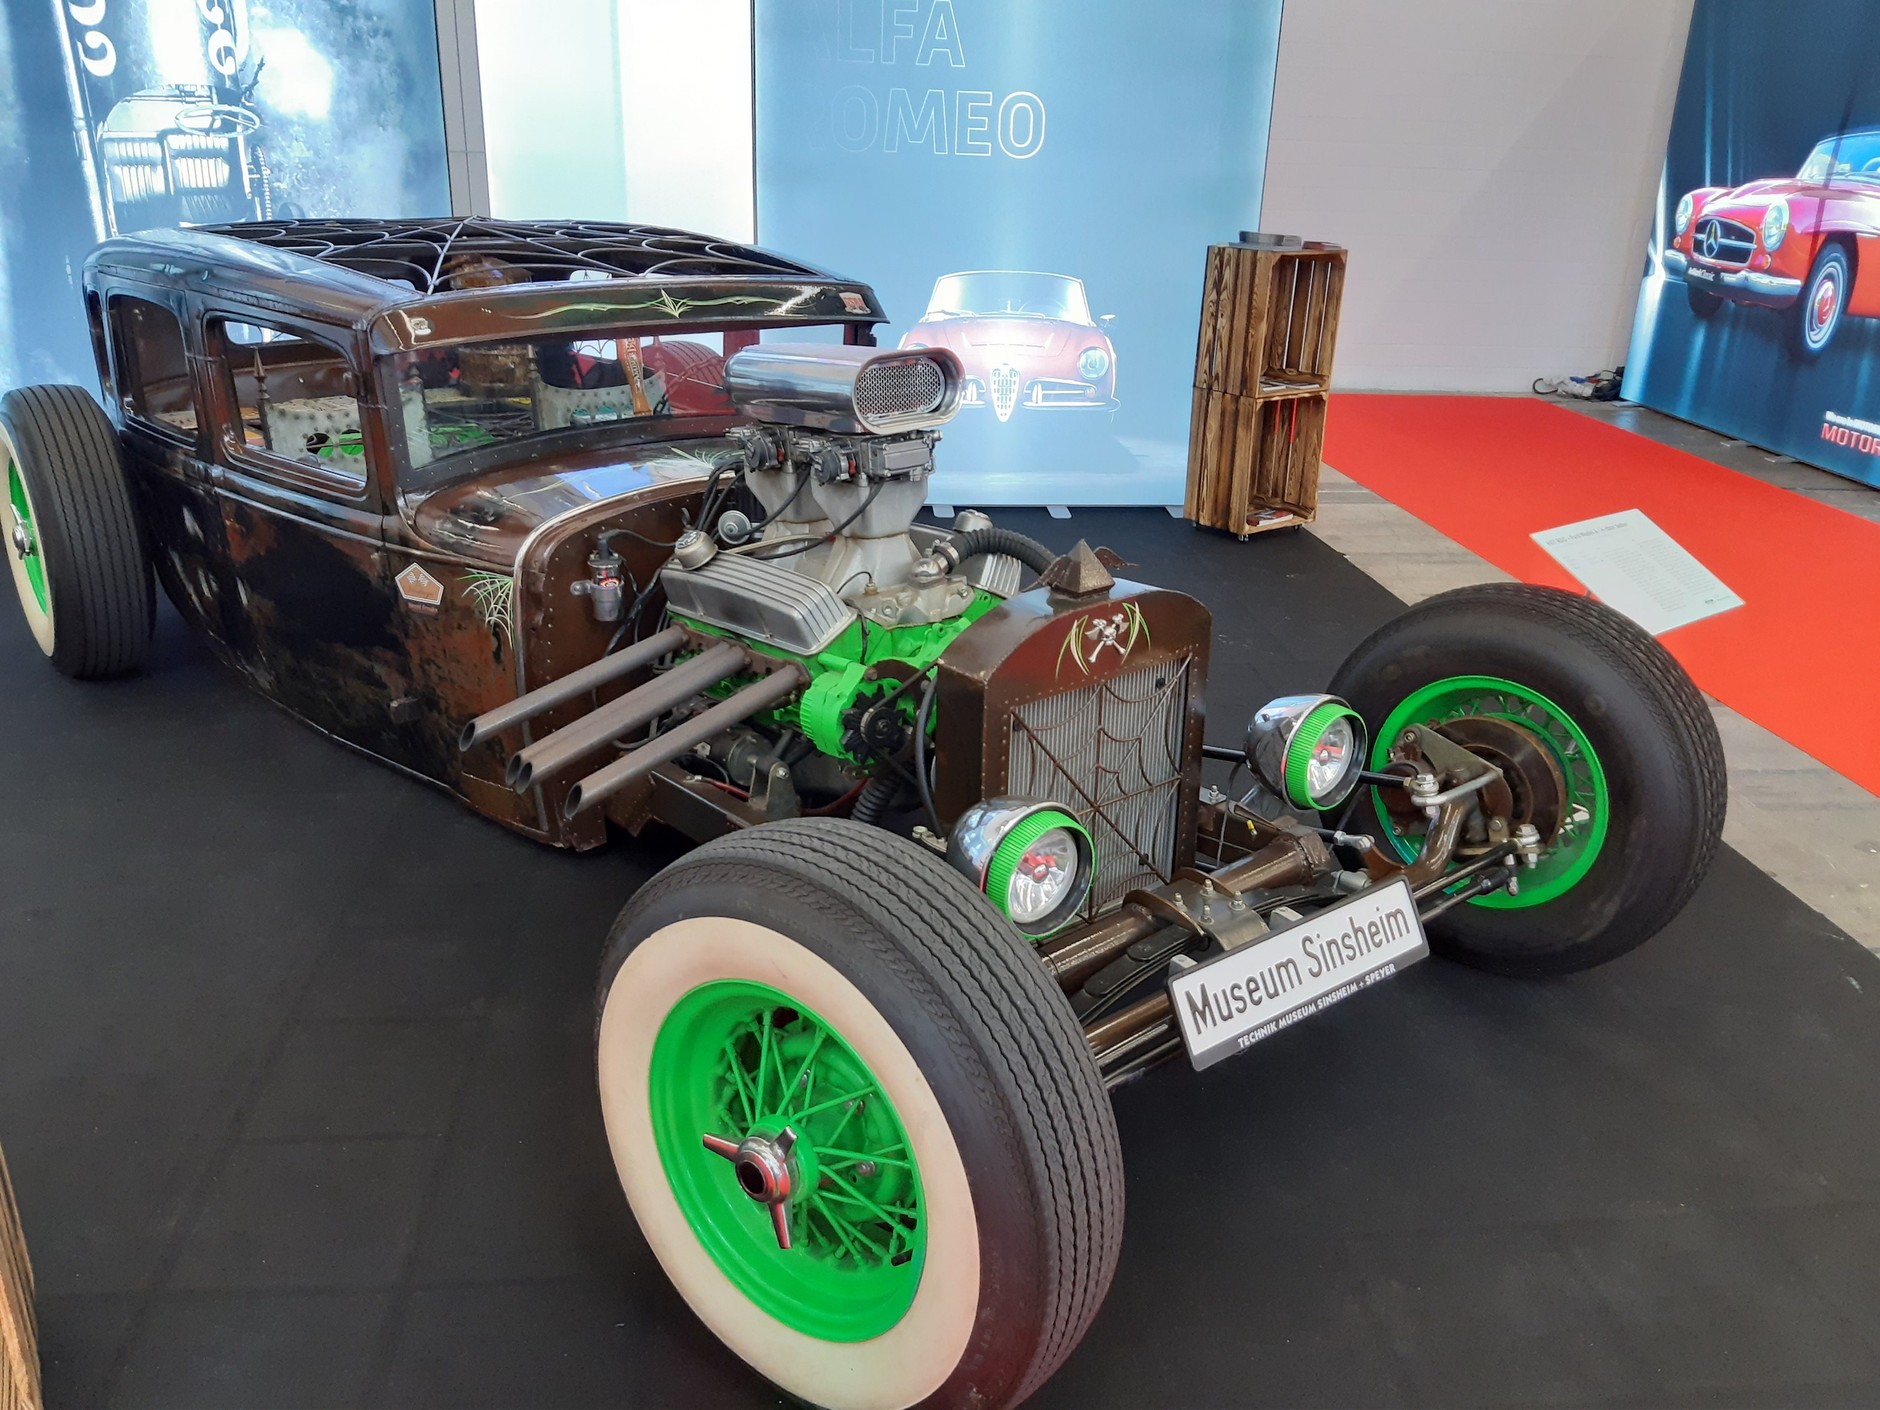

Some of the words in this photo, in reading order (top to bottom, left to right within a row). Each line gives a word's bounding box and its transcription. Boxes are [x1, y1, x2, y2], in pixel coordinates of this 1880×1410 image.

[1184, 953, 1303, 1035] Museum
[1301, 906, 1411, 978] Sinsheim
[1237, 1021, 1278, 1048] TECHNIK
[1278, 1003, 1317, 1030] MUSEUM
[1316, 984, 1359, 1010] SINSHEIM
[1364, 963, 1396, 986] SPEYER
